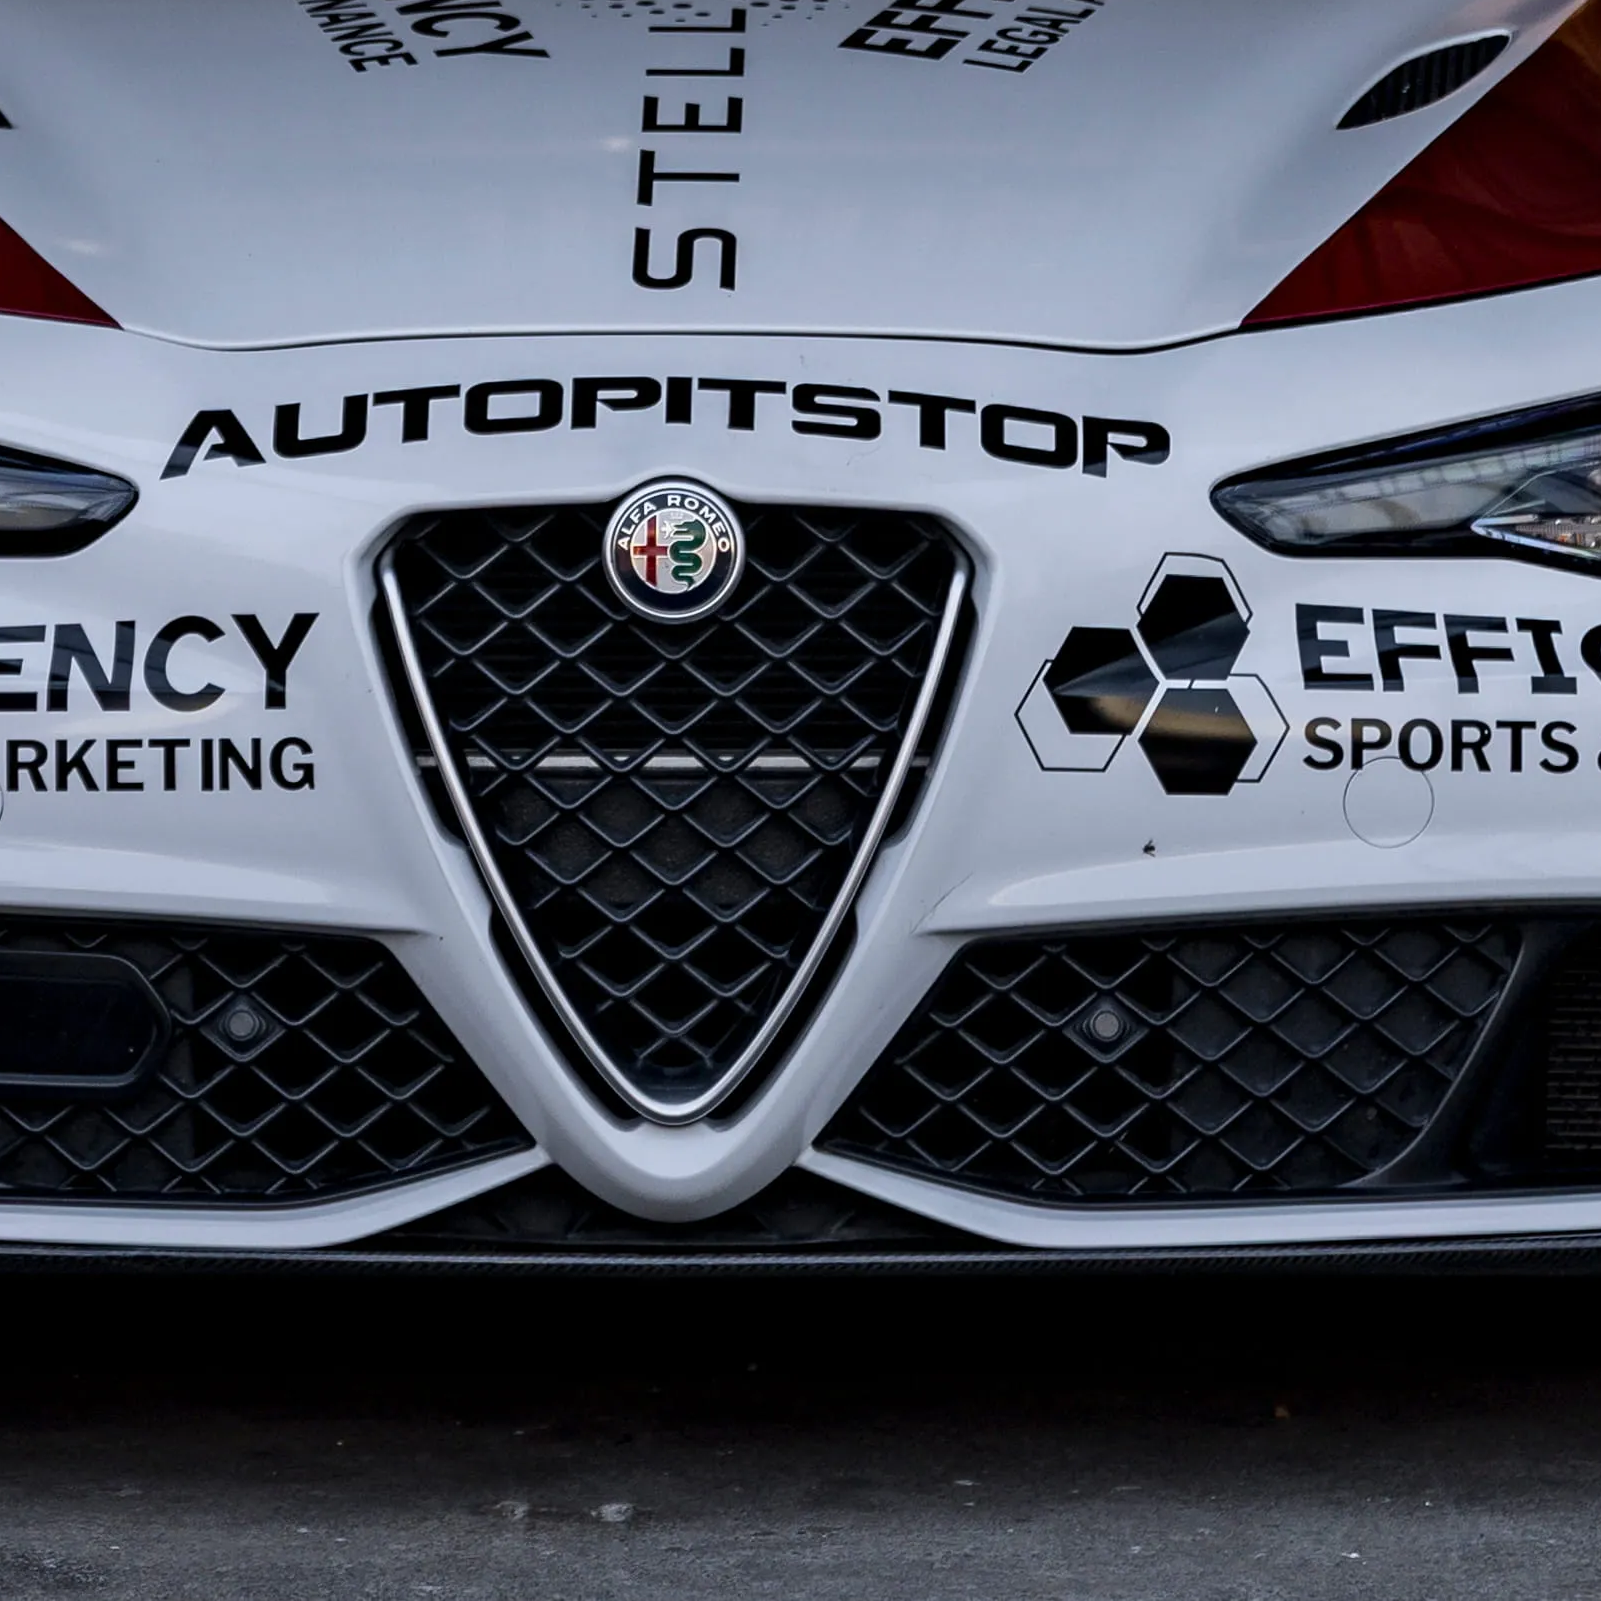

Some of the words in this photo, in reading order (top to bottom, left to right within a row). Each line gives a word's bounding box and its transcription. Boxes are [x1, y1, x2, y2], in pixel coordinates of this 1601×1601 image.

[962, 6, 1096, 74] LEGAL
[159, 374, 1172, 480] AUTOPITSTOP
[617, 500, 657, 551] ALFA
[667, 494, 731, 553] ROMEO
[1300, 715, 1580, 776] SPORTS
